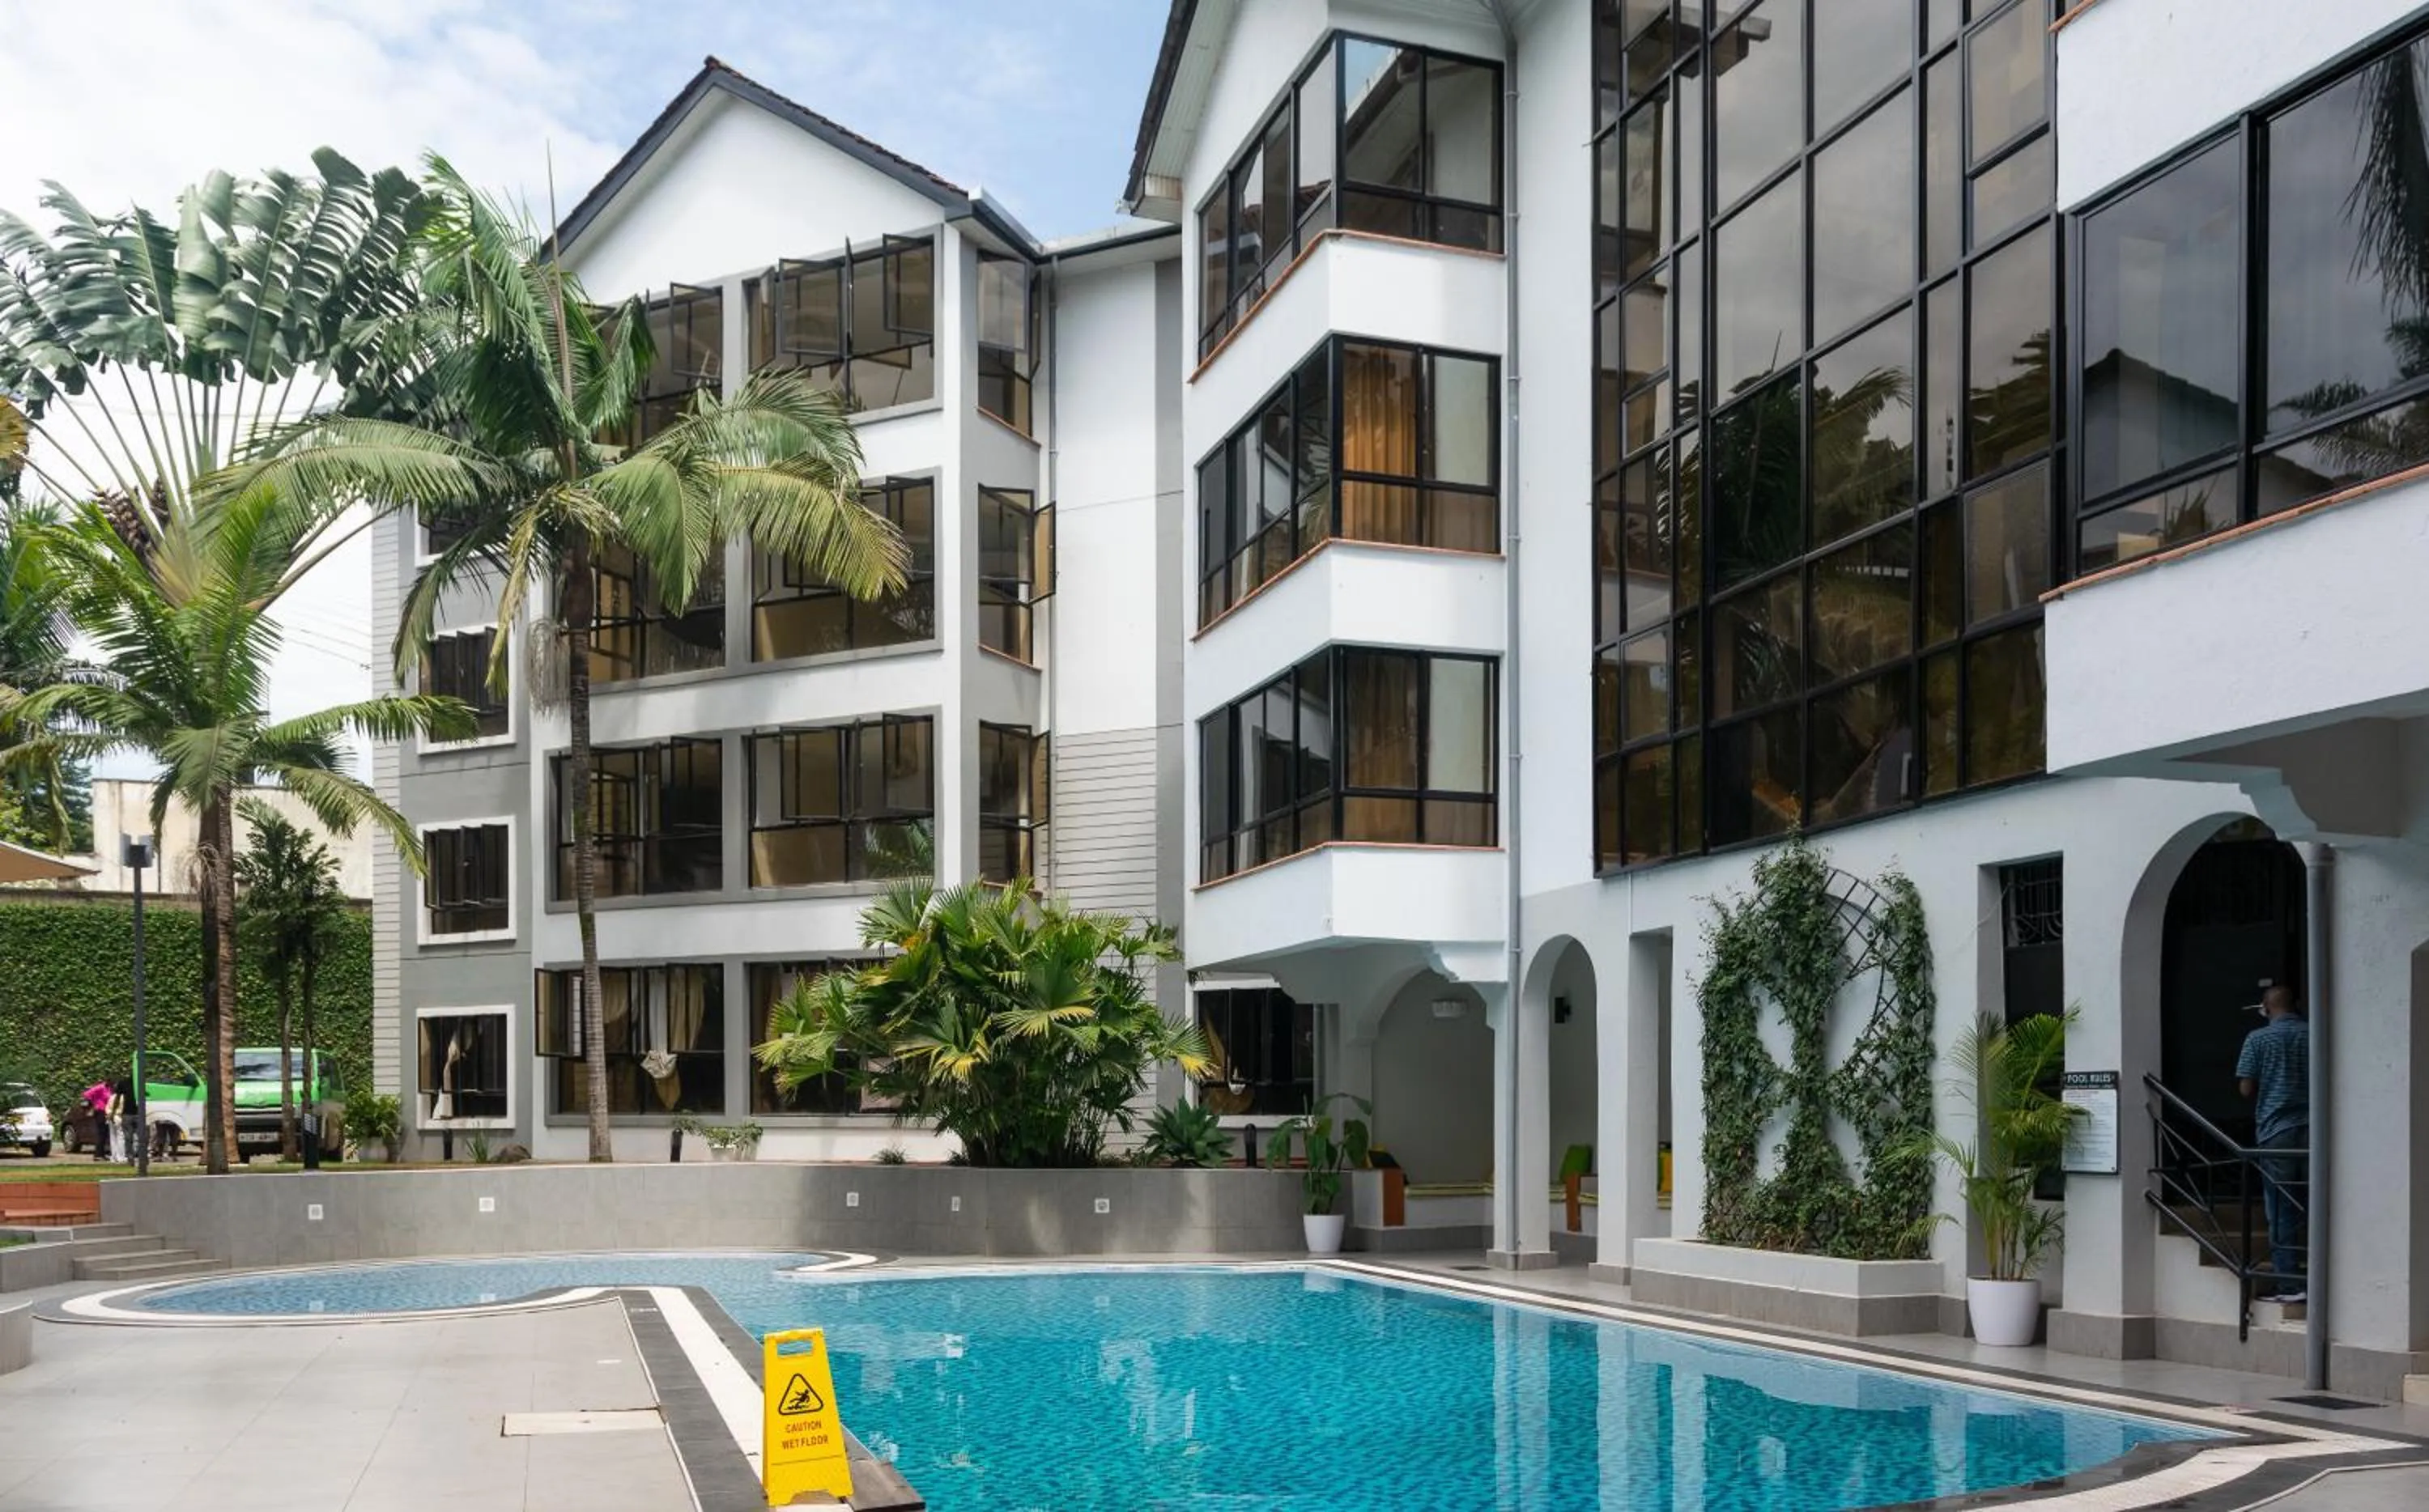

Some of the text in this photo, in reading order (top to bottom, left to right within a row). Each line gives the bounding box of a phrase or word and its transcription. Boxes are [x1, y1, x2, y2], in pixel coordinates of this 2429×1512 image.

[2067, 1074, 2087, 1083] POOL
[786, 1421, 822, 1433] CAUTION
[782, 1434, 828, 1450] WET FLOOR
